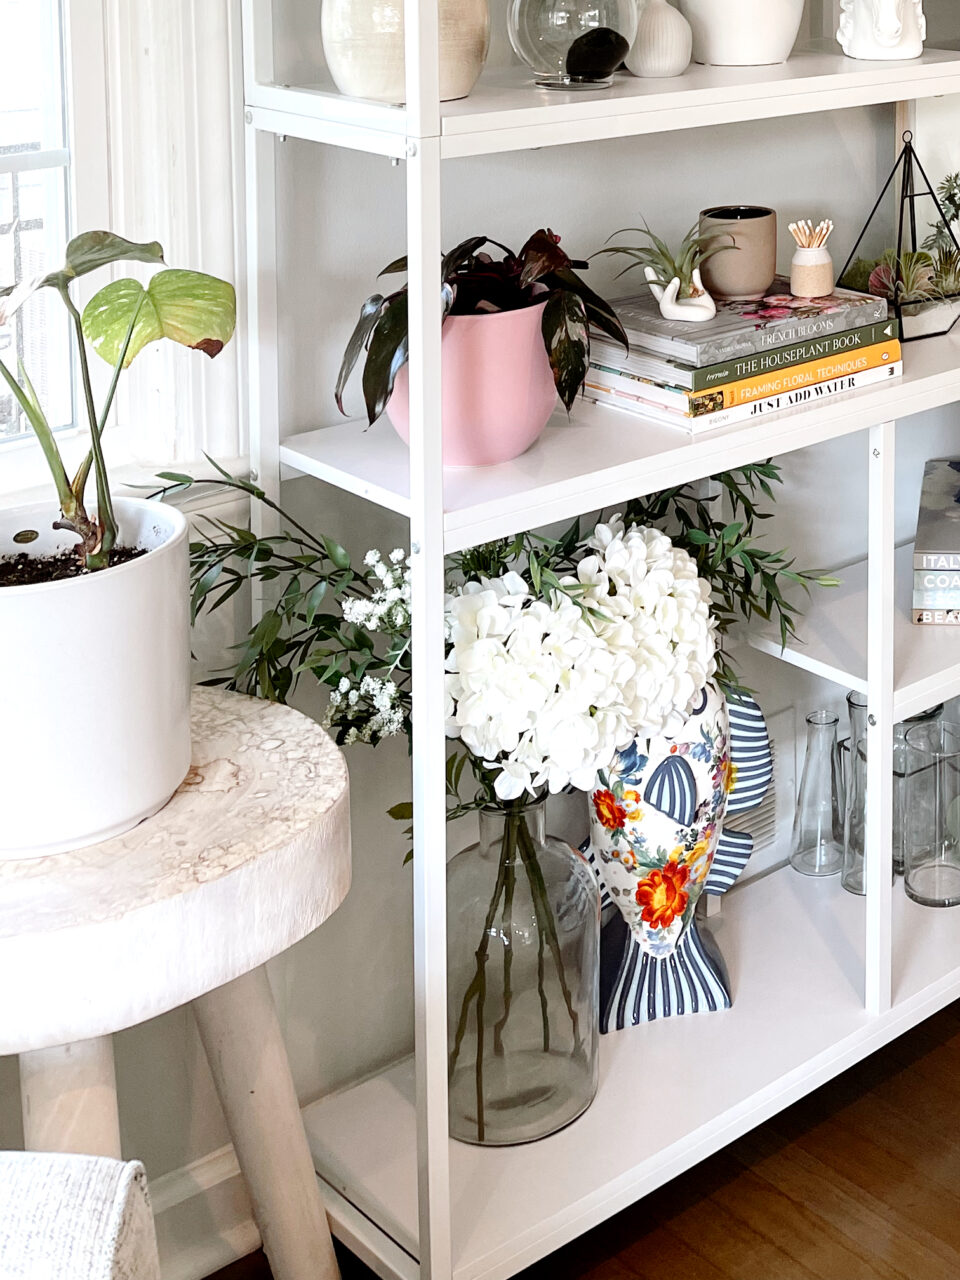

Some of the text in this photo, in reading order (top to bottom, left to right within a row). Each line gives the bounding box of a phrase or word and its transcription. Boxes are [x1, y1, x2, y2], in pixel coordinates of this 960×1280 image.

[761, 318, 834, 347] FRENCH BLOOMS
[735, 359, 758, 376] THE
[760, 340, 831, 369] HOUSEPLANT
[833, 332, 861, 350] BOOK
[740, 380, 781, 400] FRAMING
[783, 373, 815, 389] FLORAL
[815, 356, 868, 380] TECHNIQUES
[750, 377, 856, 416] JUST ADD WATER
